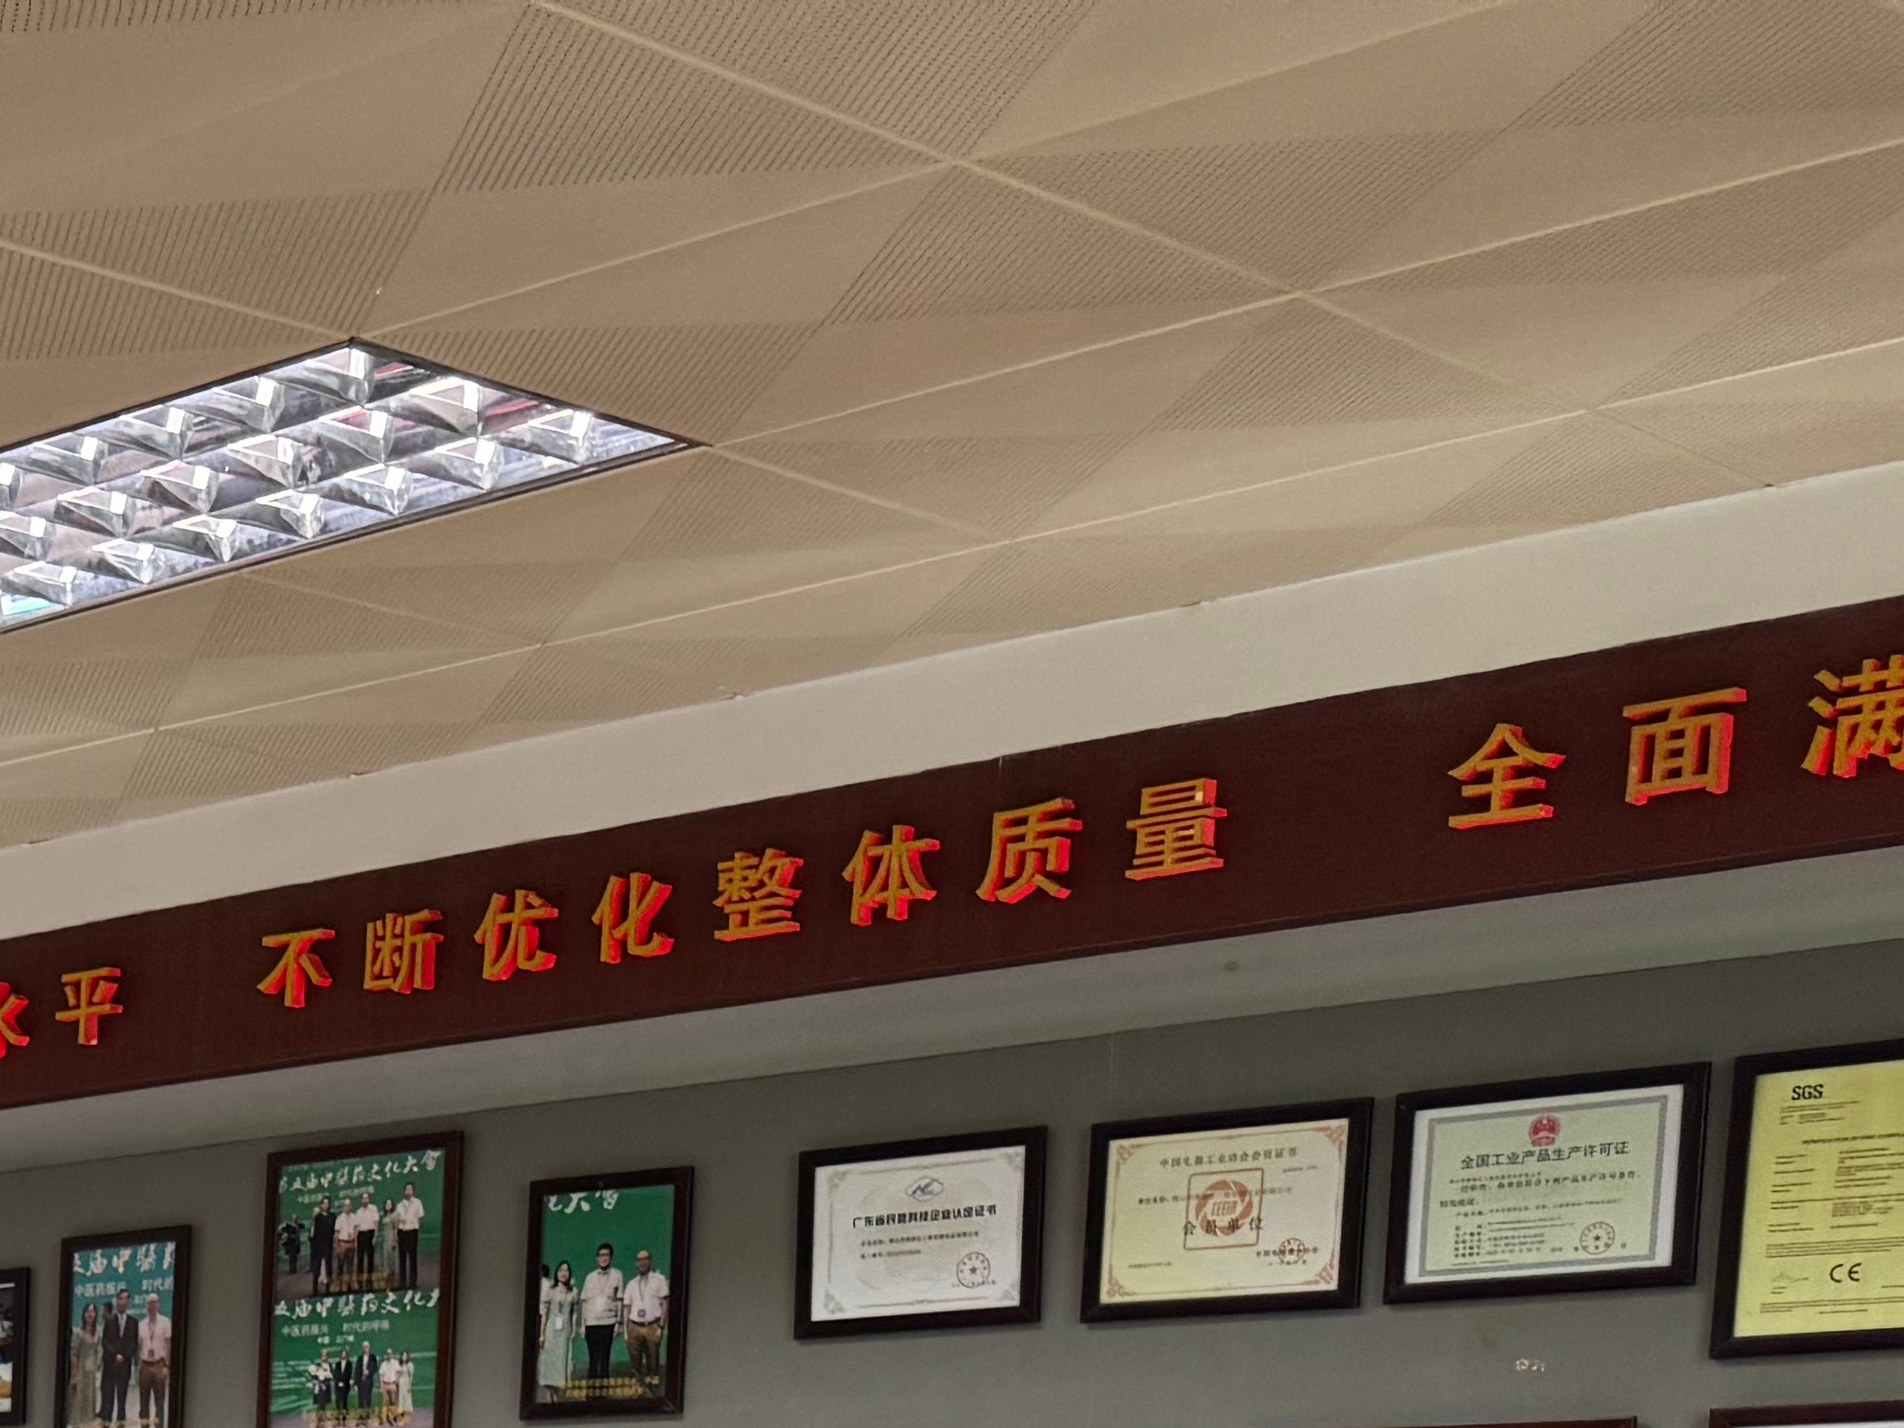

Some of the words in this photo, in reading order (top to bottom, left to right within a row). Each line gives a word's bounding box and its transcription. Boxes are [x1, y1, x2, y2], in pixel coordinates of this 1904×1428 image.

[1444, 654, 1904, 832] 全面满
[256, 777, 1230, 1010] 不断优化整体质量
[1791, 1083, 1825, 1101] SGS
[1159, 1146, 1299, 1169] 中国电器工业协会会员证书
[1460, 1141, 1630, 1171] 全国工业产品生产许可证
[852, 1203, 998, 1229] 广东省民营科技企业认定证书
[1182, 1215, 1264, 1238] 会员单位
